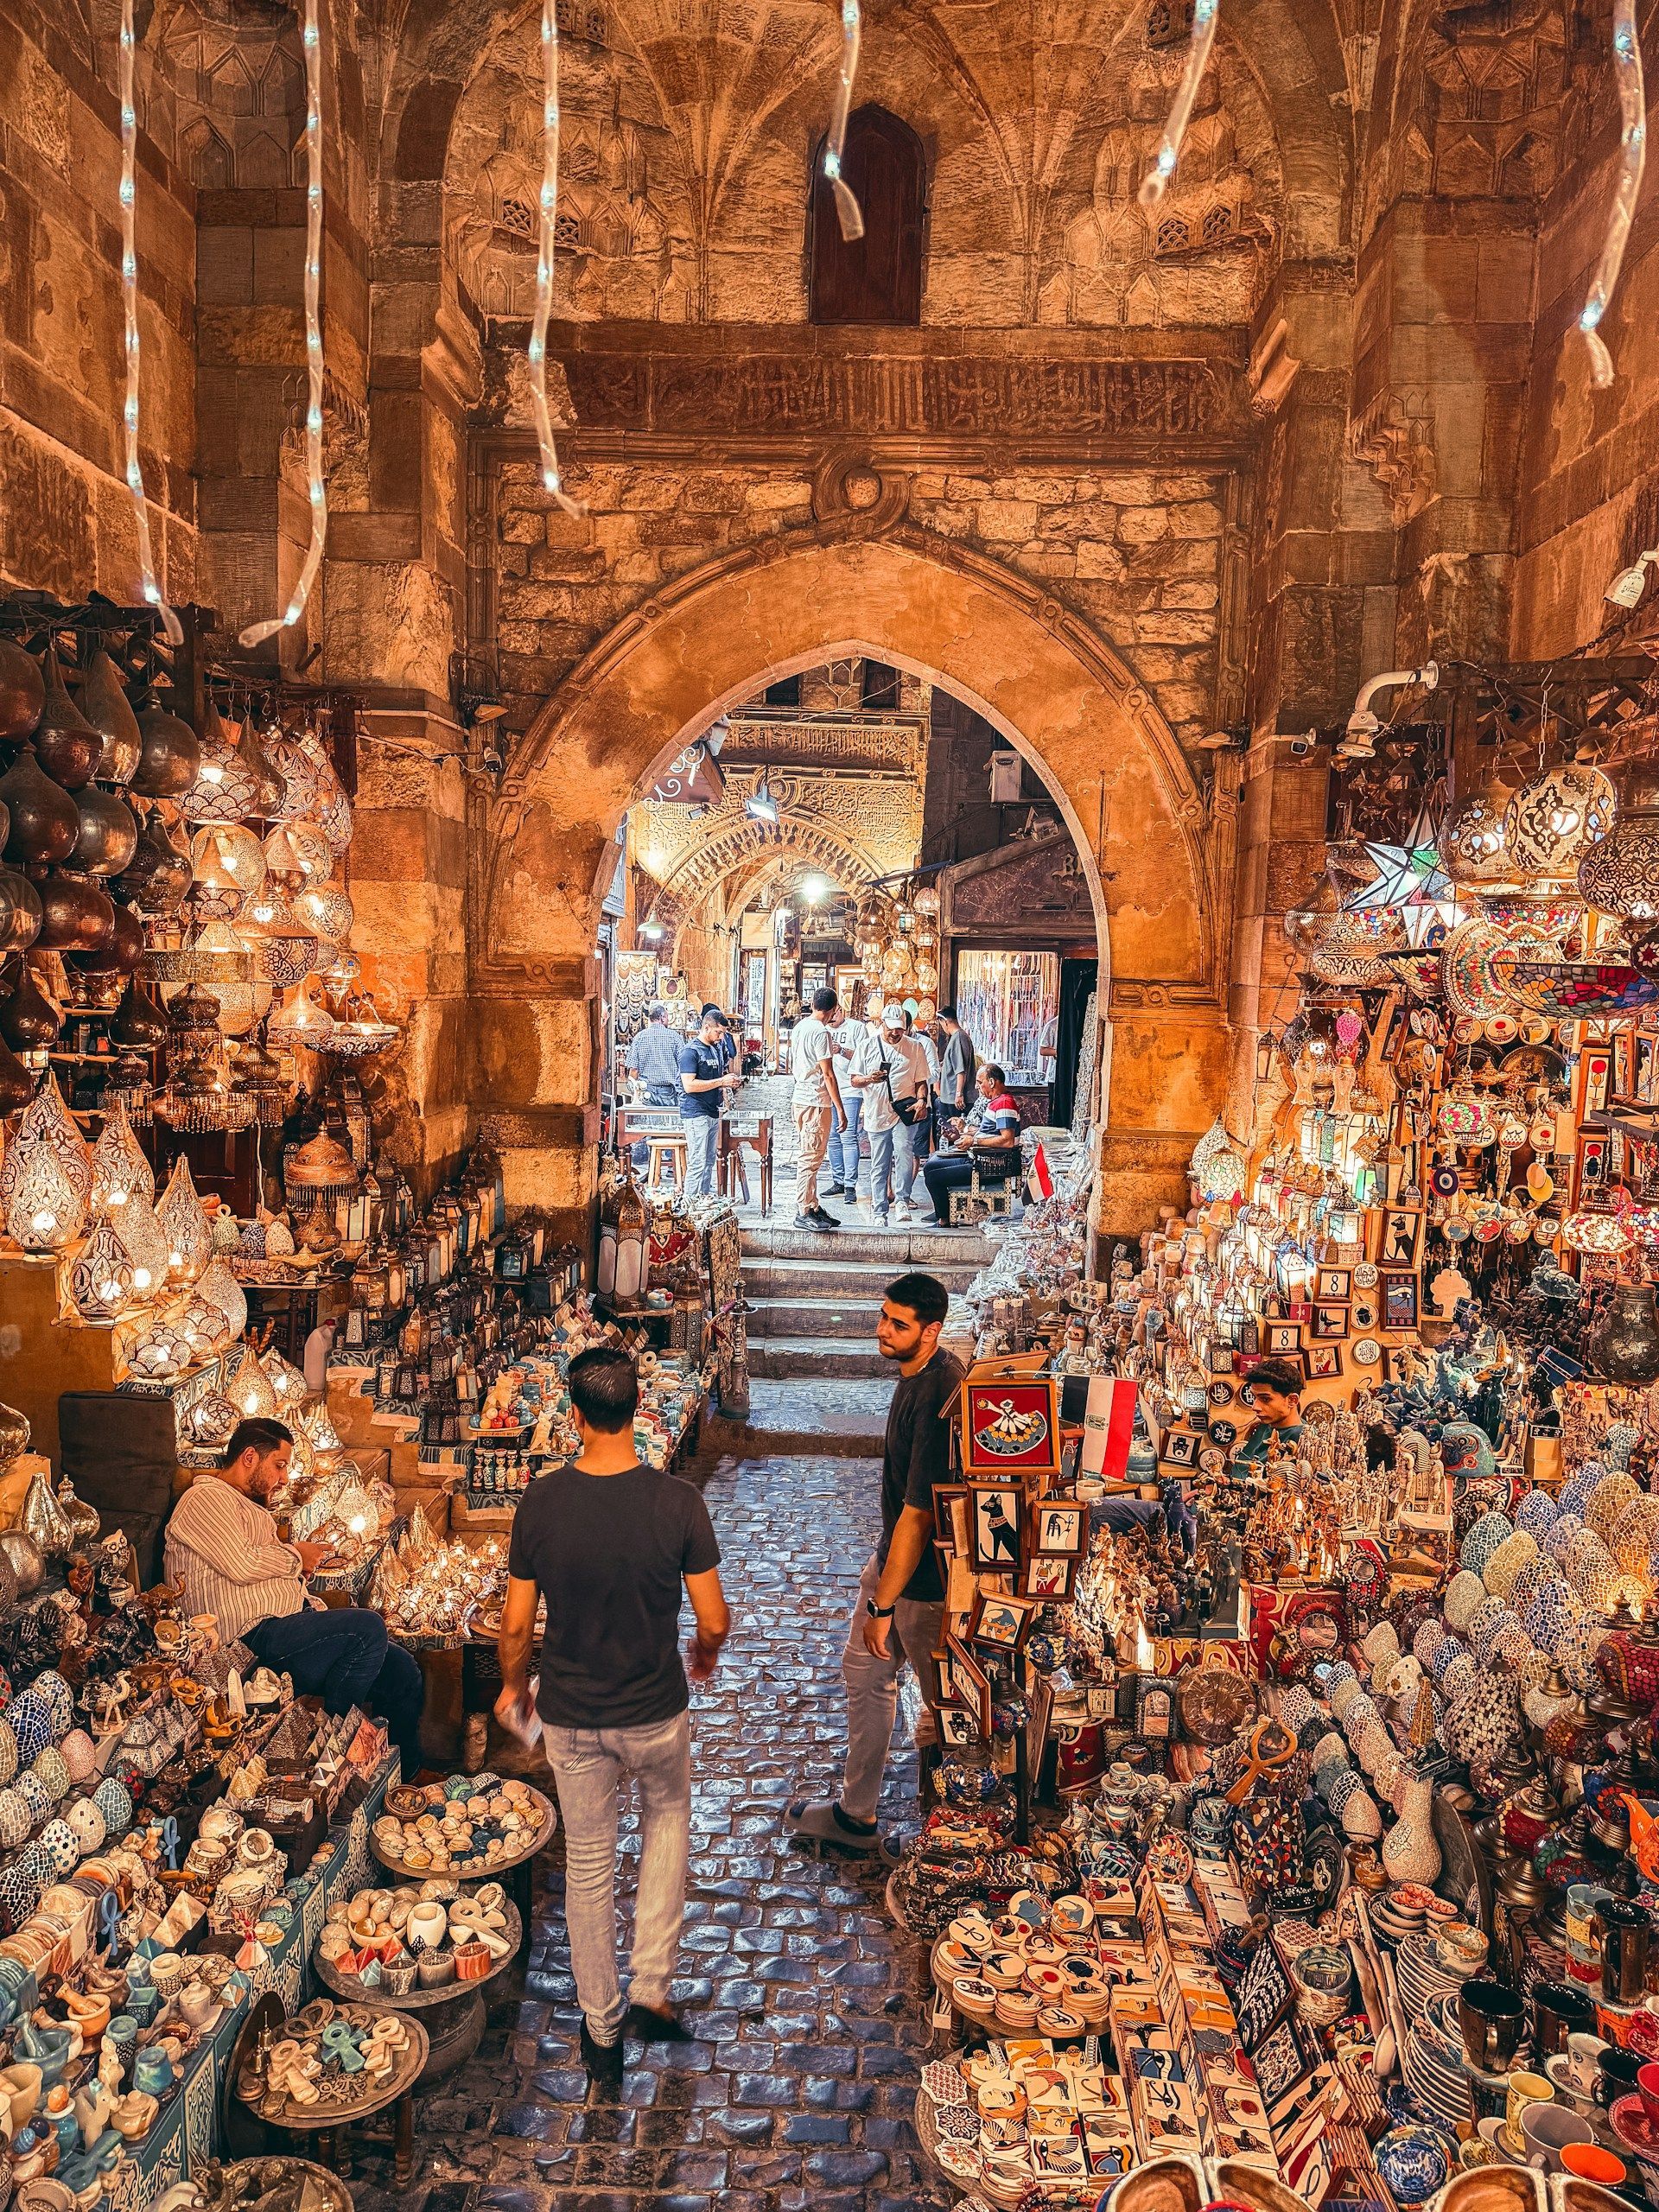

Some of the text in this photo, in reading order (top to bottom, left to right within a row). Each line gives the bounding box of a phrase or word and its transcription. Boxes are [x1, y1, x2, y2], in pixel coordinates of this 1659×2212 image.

[1330, 1274, 1338, 1293] 8
[1281, 1330, 1289, 1347] 8
[1212, 1891, 1243, 1903] 4
